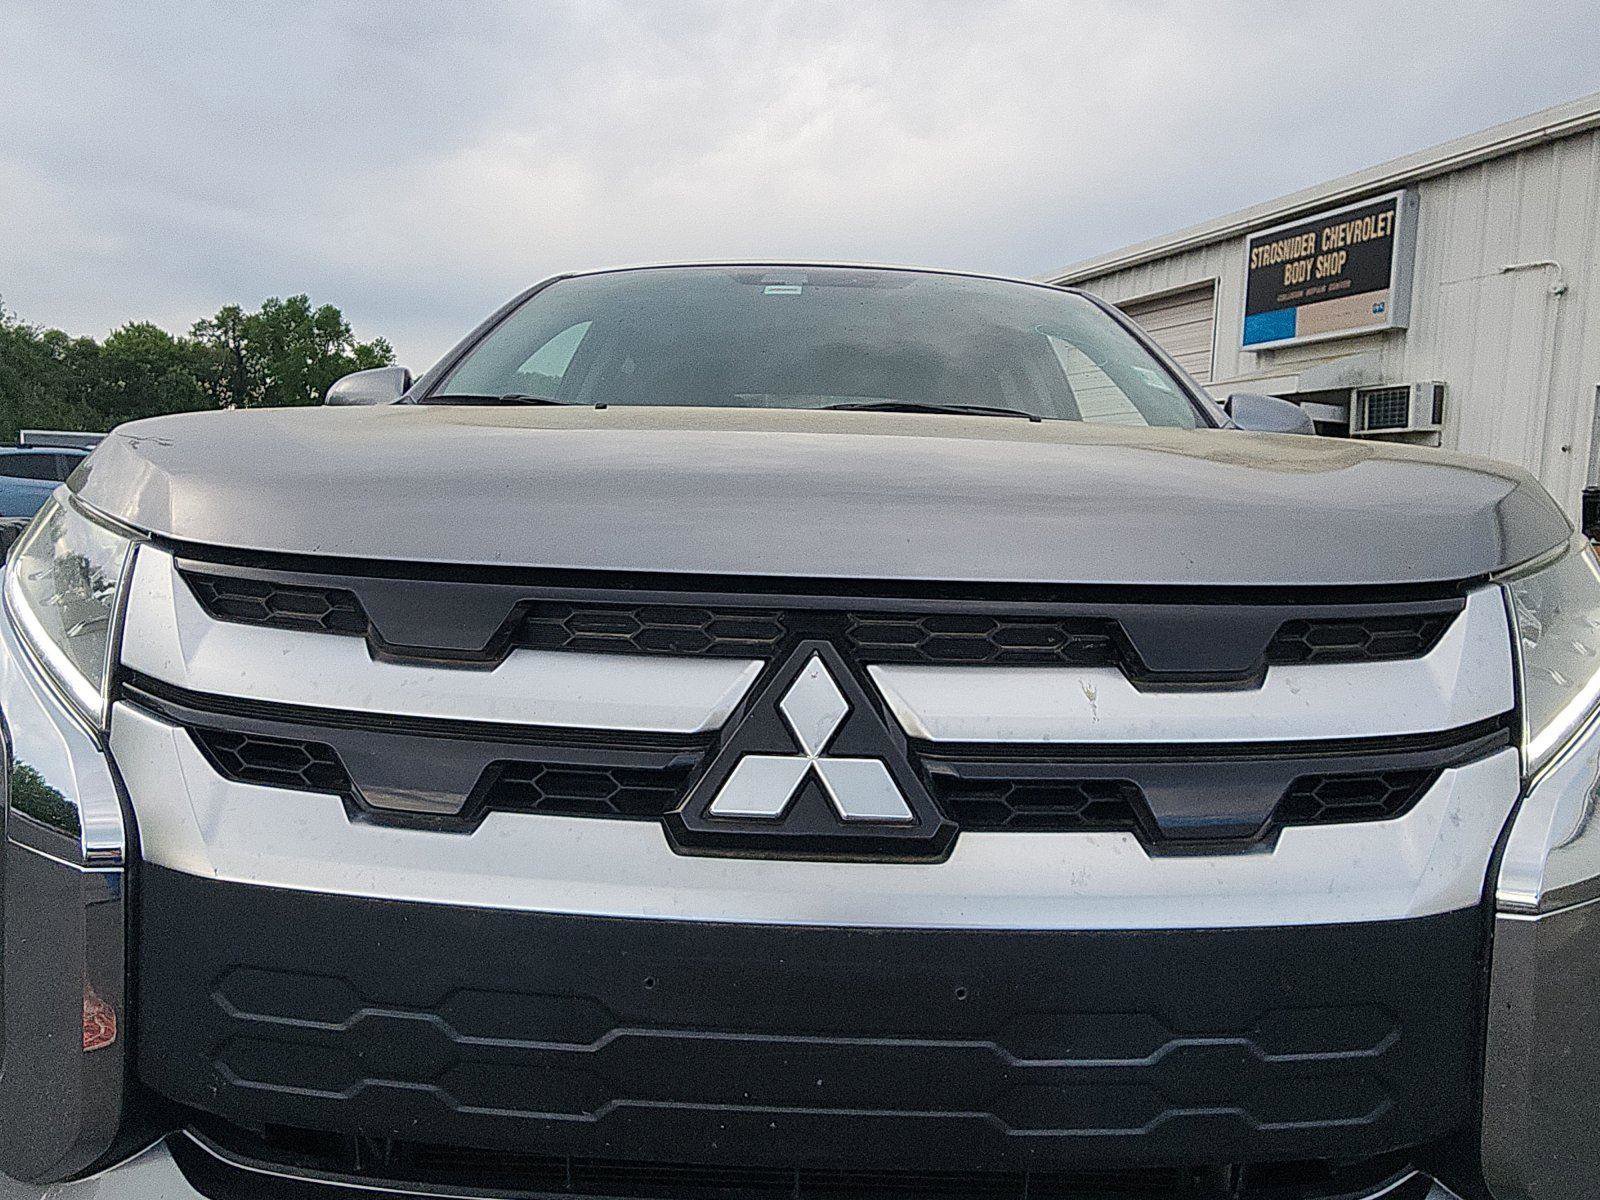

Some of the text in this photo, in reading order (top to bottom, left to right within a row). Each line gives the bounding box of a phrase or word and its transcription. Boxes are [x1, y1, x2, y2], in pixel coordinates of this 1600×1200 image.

[1251, 211, 1395, 270] STROSNIDER CHEVROLET
[1284, 251, 1347, 286] BODY SHOP
